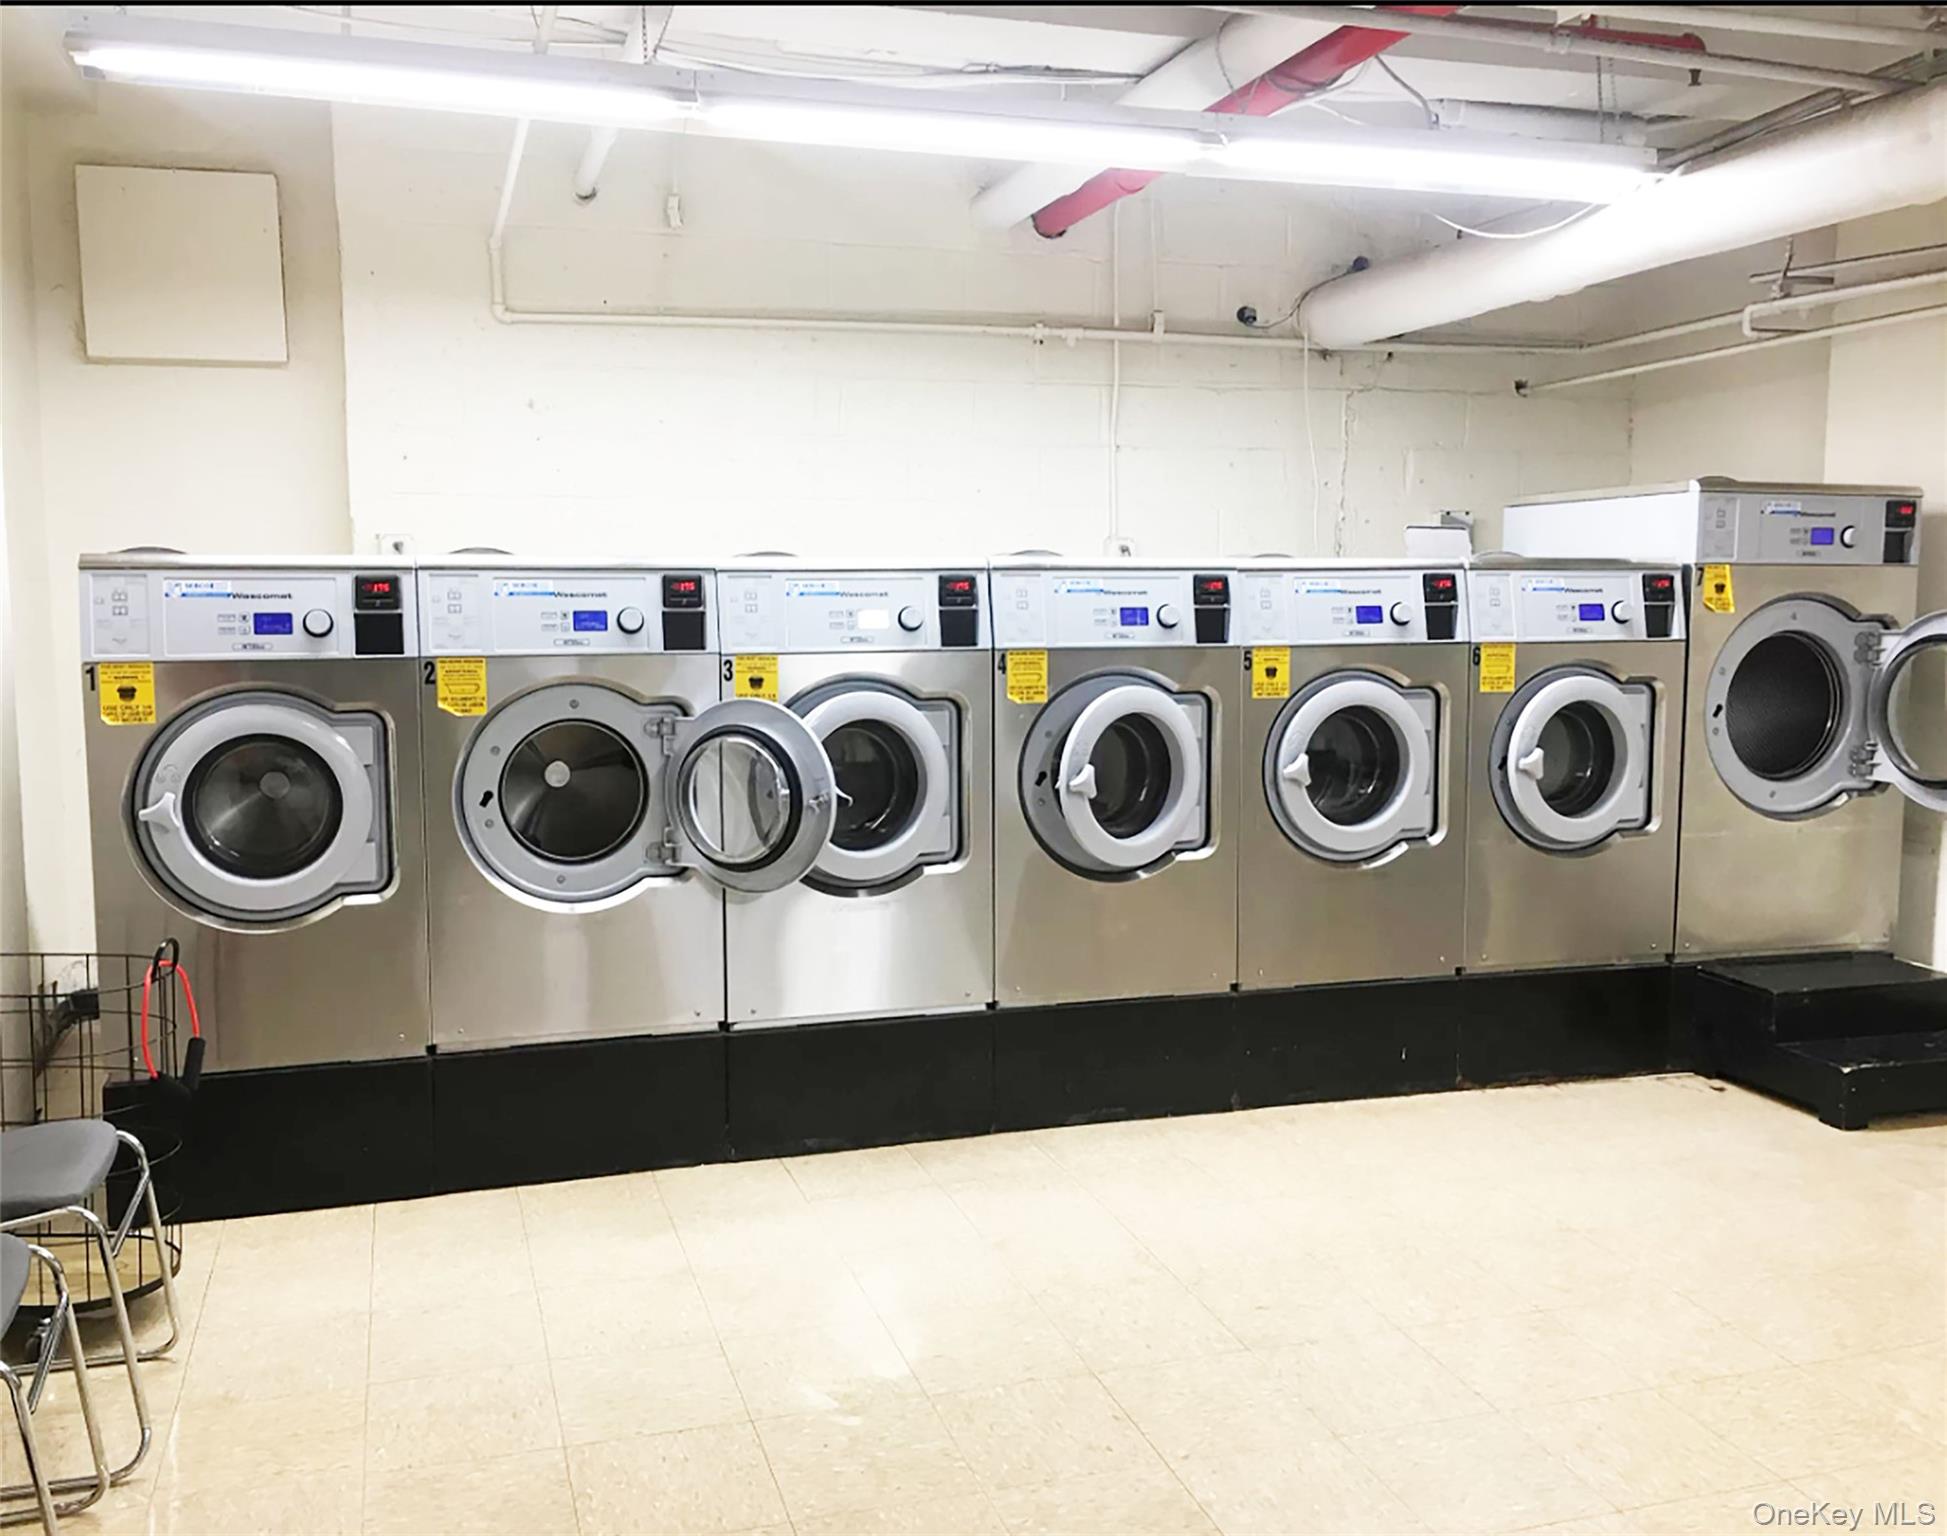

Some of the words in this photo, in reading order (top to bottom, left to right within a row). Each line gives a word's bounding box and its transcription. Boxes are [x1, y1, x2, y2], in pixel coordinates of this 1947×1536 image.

[1697, 567, 1705, 586] 7
[231, 592, 293, 600] Wascomat
[997, 652, 1007, 675] 4
[1244, 650, 1252, 671] 5
[1472, 646, 1481, 666] 6
[85, 665, 96, 691] 1
[424, 660, 435, 685] 2
[723, 659, 733, 682] 3
